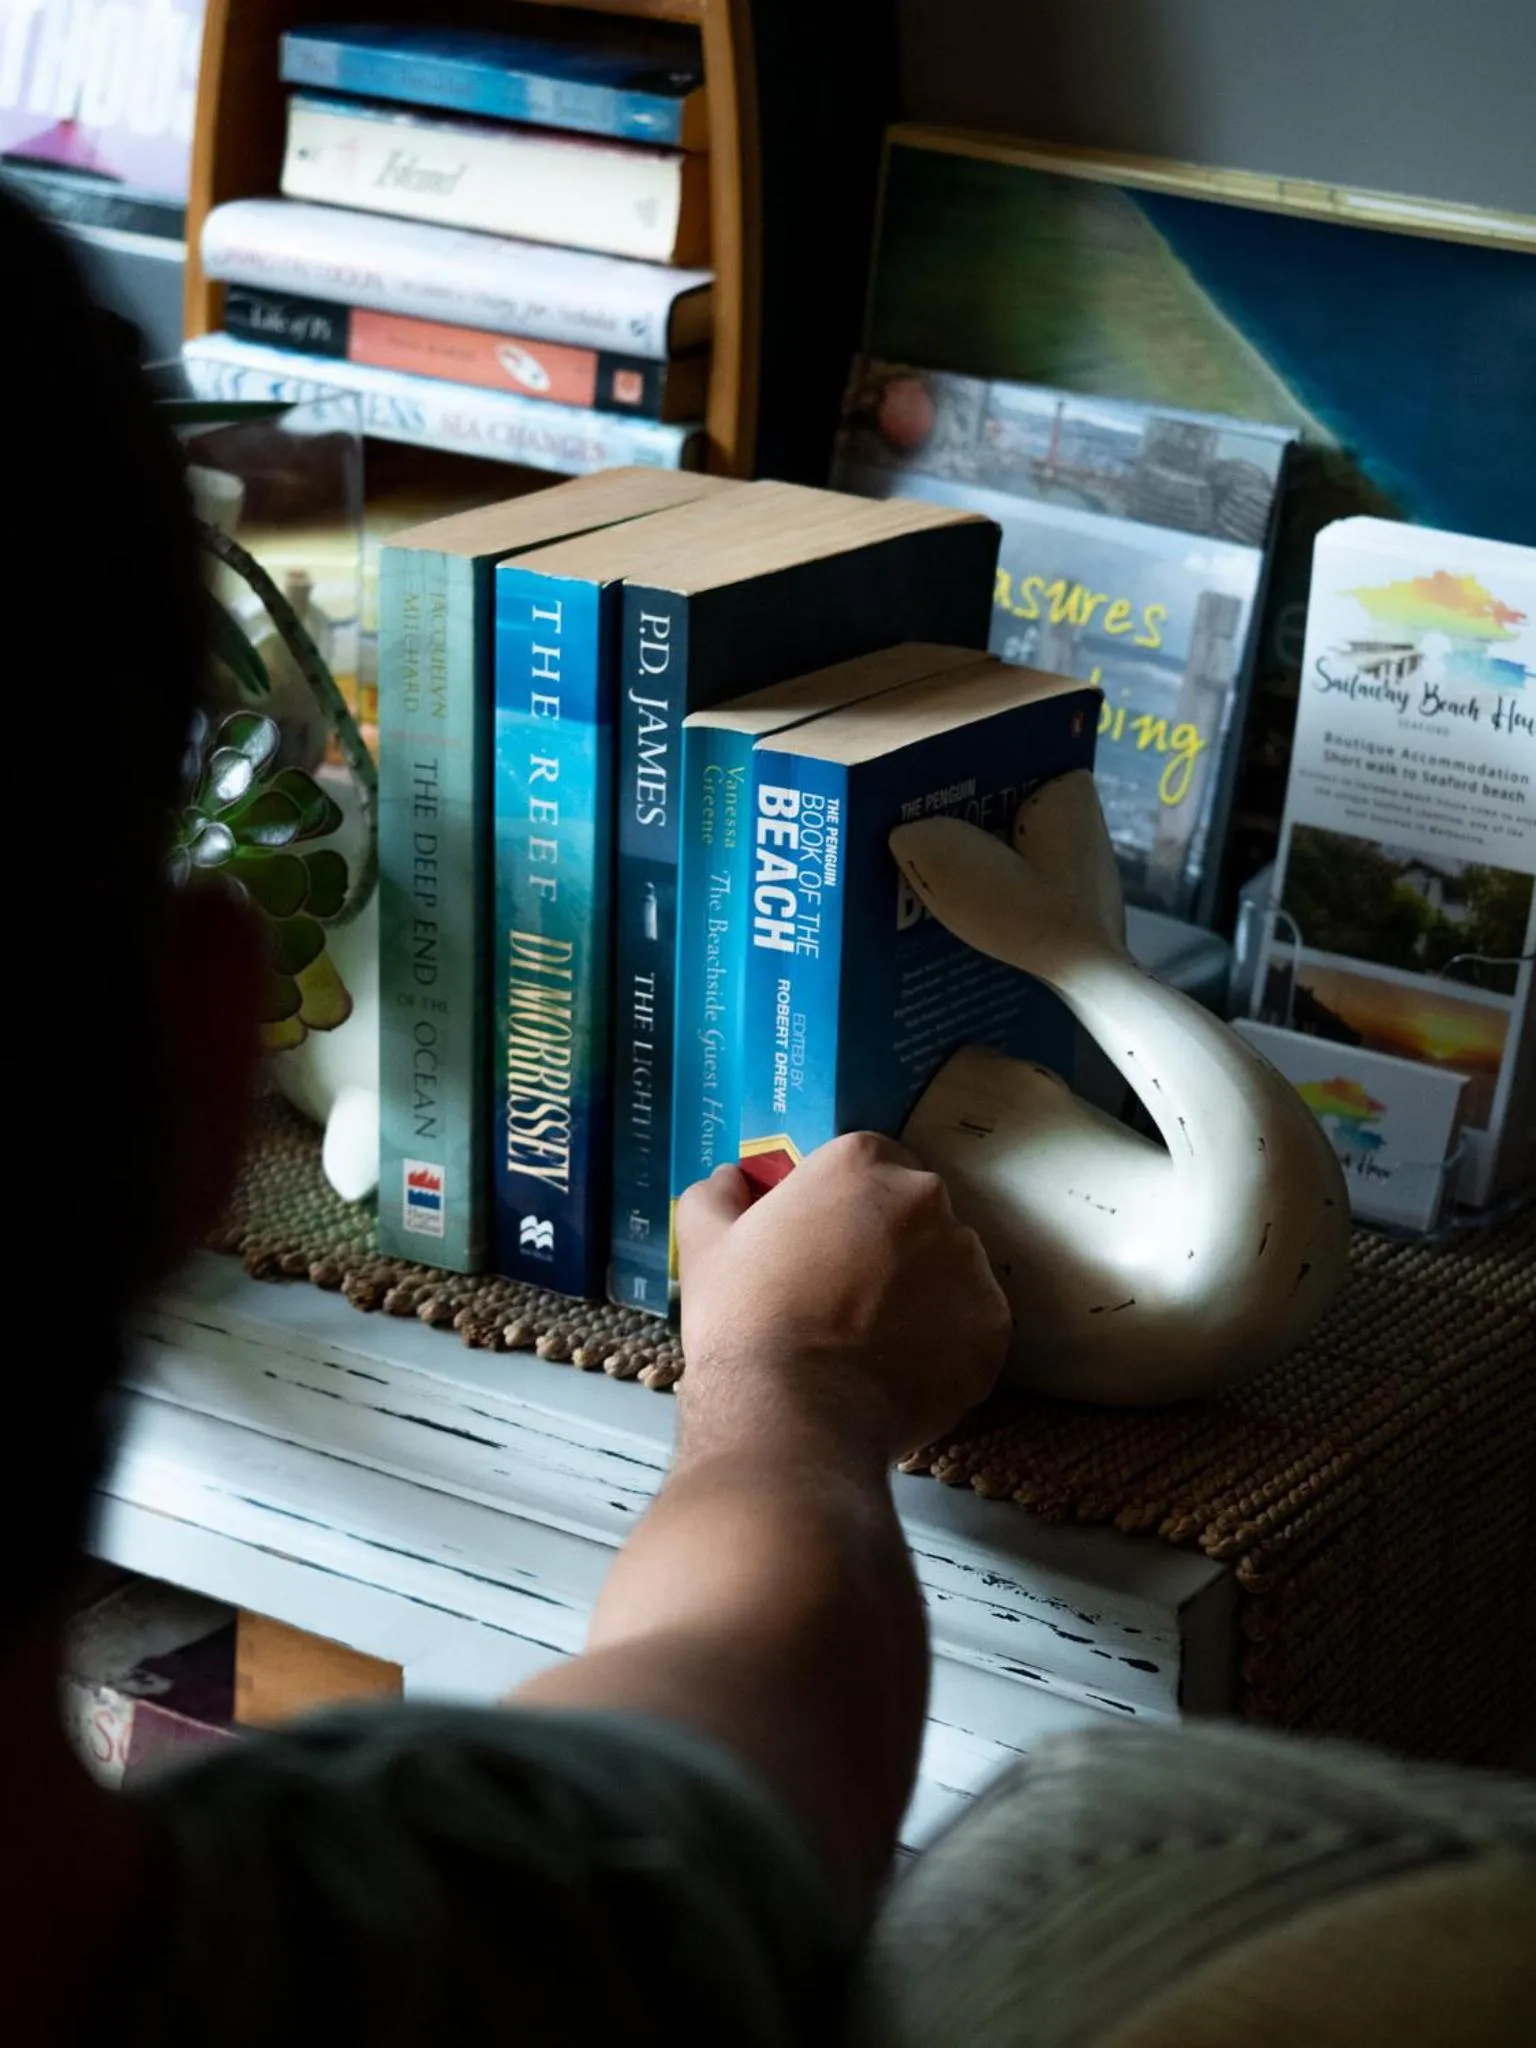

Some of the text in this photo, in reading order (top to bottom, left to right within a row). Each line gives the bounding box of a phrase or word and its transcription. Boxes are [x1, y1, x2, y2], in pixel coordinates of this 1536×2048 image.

[403, 594, 420, 713] MITCHARD
[428, 591, 447, 719] JACQUELYN
[994, 566, 1169, 649] asures
[528, 600, 563, 905] THE REEF
[628, 611, 671, 828] P.D. JAMES
[1418, 682, 1481, 721] Beach
[701, 765, 723, 845] Greene
[723, 766, 745, 849] Vanessa
[901, 795, 925, 820] THE
[925, 775, 977, 812] PENGUIN
[1323, 750, 1526, 805] Short walk to Seaford beach
[1324, 729, 1530, 786] Boutique Accommodation
[412, 758, 438, 986] THE DEEP END
[753, 783, 801, 955] BEACH
[795, 792, 825, 960] BOOK OF THE
[823, 798, 840, 887] THE PENGUIN
[510, 929, 573, 981] DI
[633, 971, 656, 1033] THE
[697, 869, 731, 1167] The Beachside Guest House
[773, 978, 792, 1114] ROBERT DREWE
[790, 1012, 807, 1094] EDITED BY
[412, 1020, 438, 1139] OCEAN
[507, 979, 573, 1194] MORRISSEY
